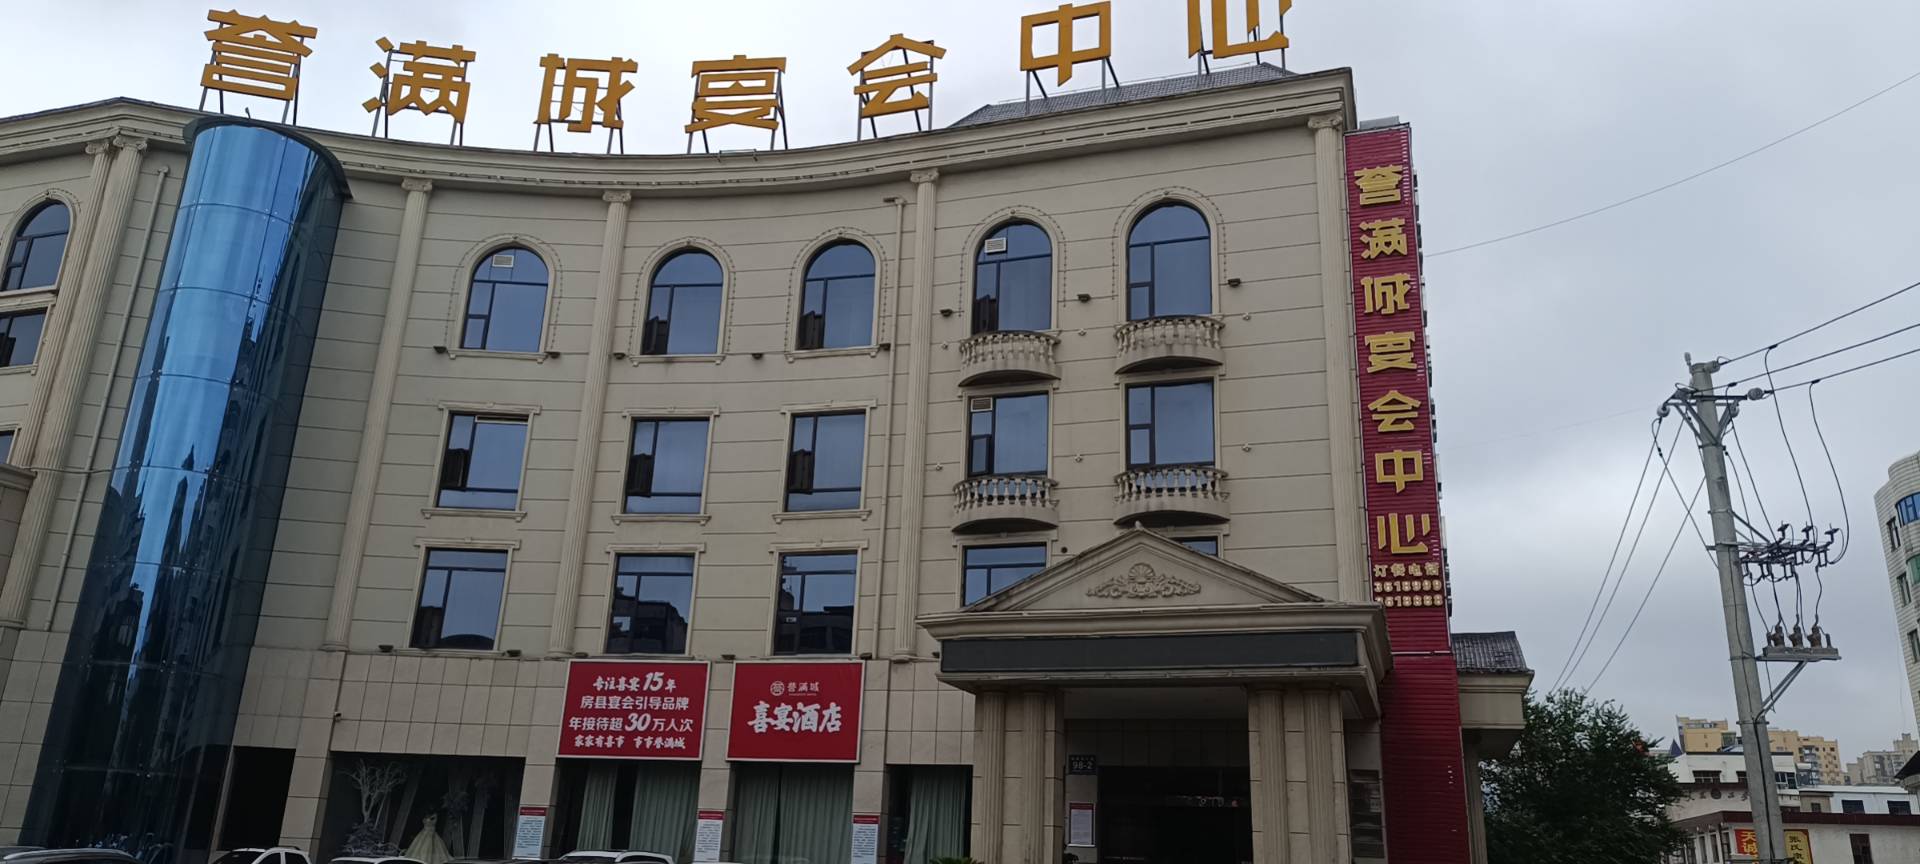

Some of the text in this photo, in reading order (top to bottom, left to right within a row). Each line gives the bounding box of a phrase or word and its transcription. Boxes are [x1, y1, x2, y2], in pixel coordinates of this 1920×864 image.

[1354, 164, 1431, 554] 誉满城宴会中心
[580, 695, 690, 710] 房县宴会引导品牌
[747, 700, 842, 733] 喜宴酒店
